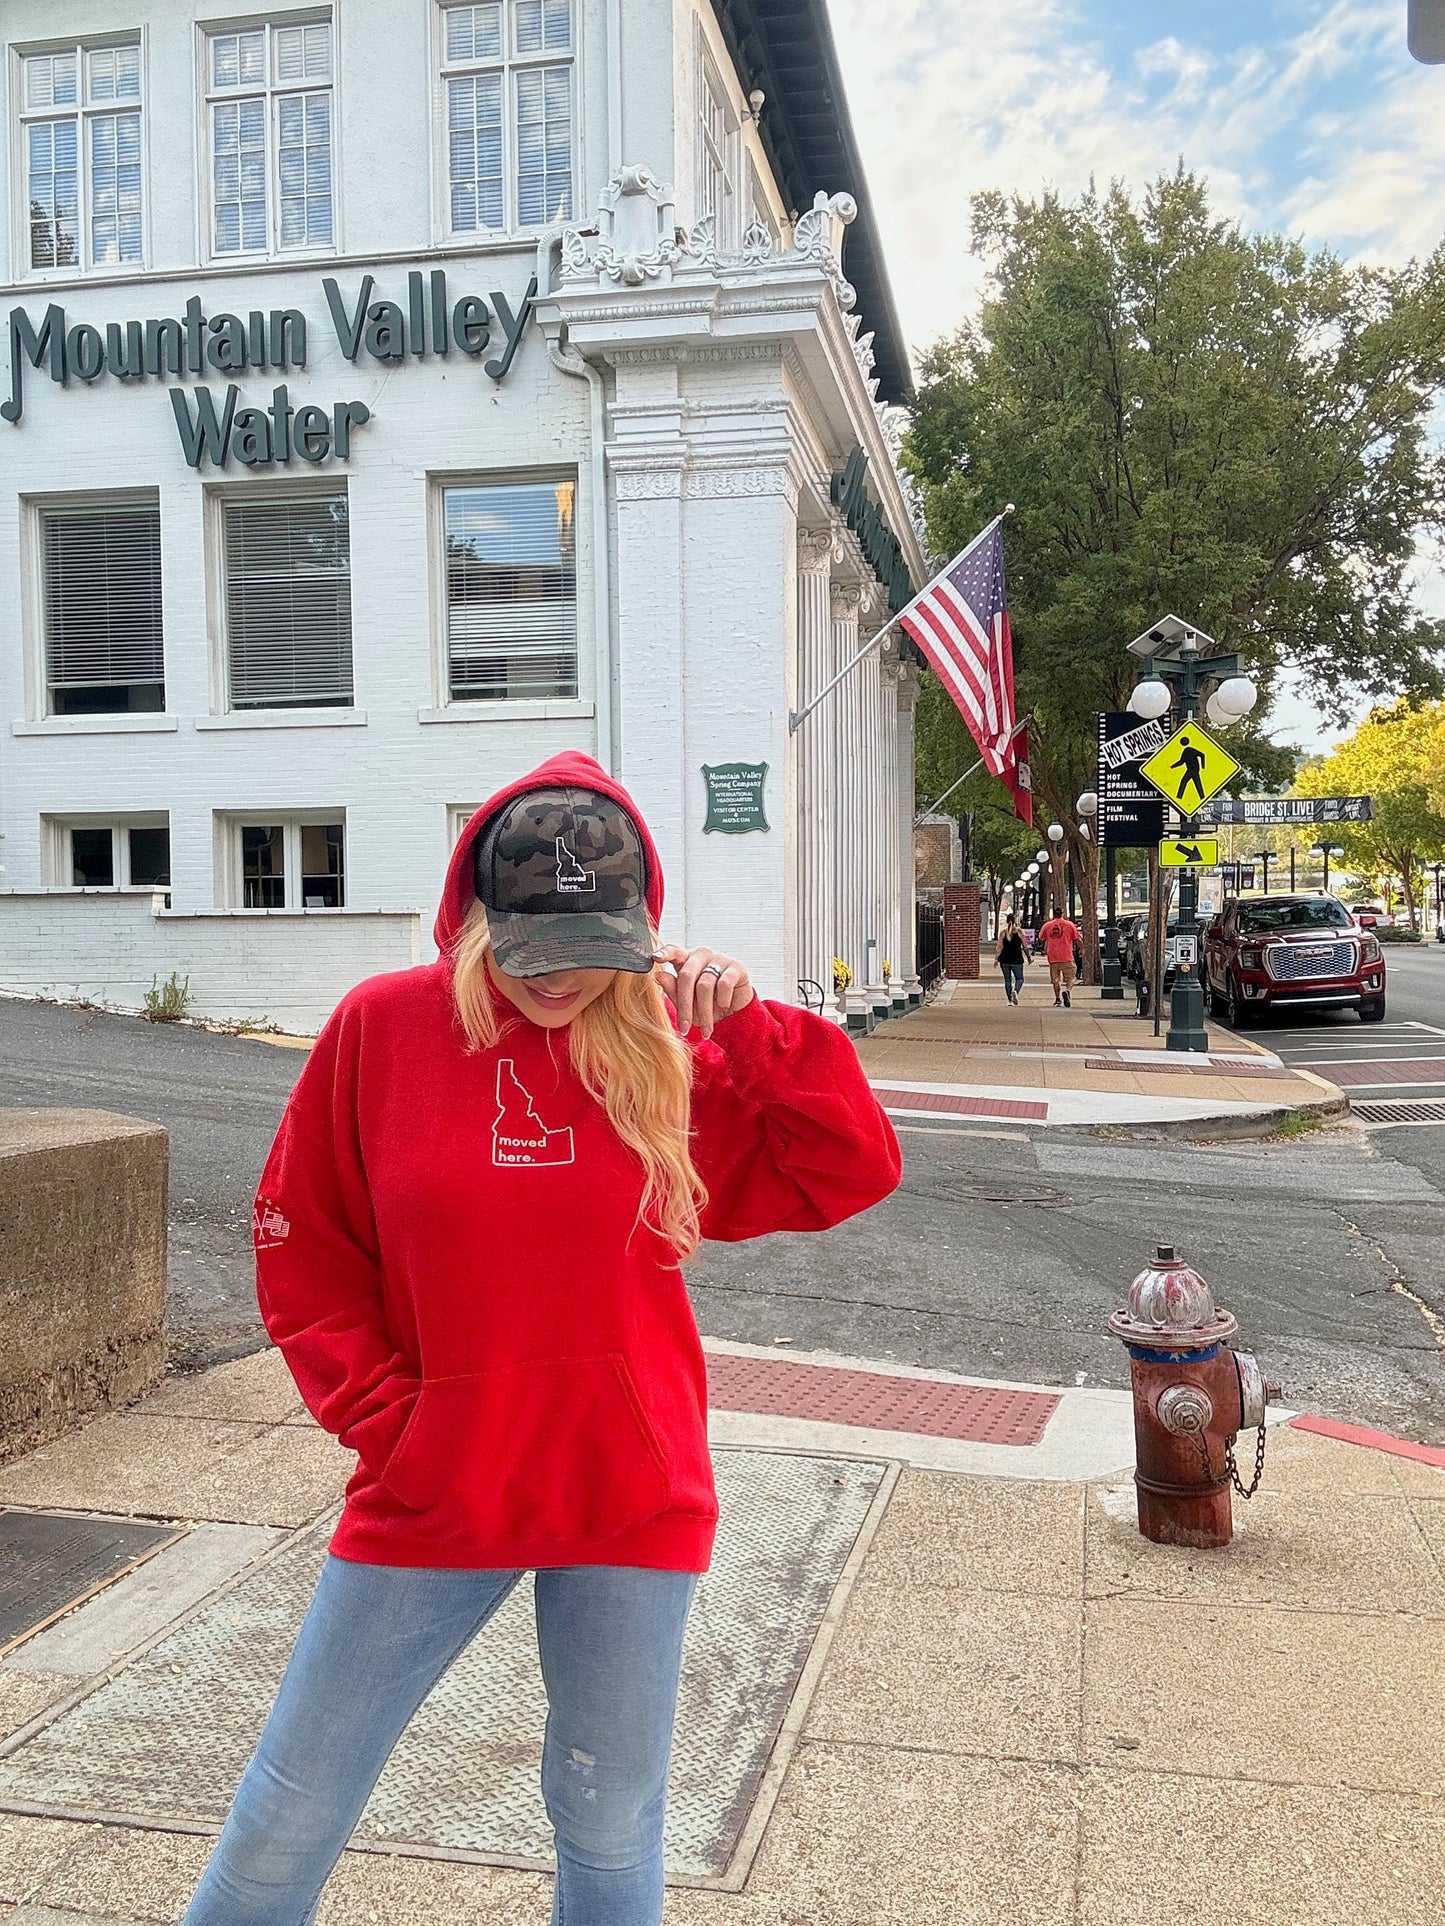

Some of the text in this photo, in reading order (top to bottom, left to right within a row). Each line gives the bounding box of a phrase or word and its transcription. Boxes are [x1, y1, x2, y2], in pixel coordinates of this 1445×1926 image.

[0, 269, 538, 423] Mountain Valley
[168, 384, 371, 468] Water
[1104, 722, 1164, 766] HOT SPRINGS
[709, 771, 762, 780] Mountain Valley
[709, 780, 762, 789] Spring Company
[1244, 801, 1315, 817] BRIDGE ST. LIVE!
[498, 1136, 547, 1148] moved
[498, 1149, 536, 1162] here.
